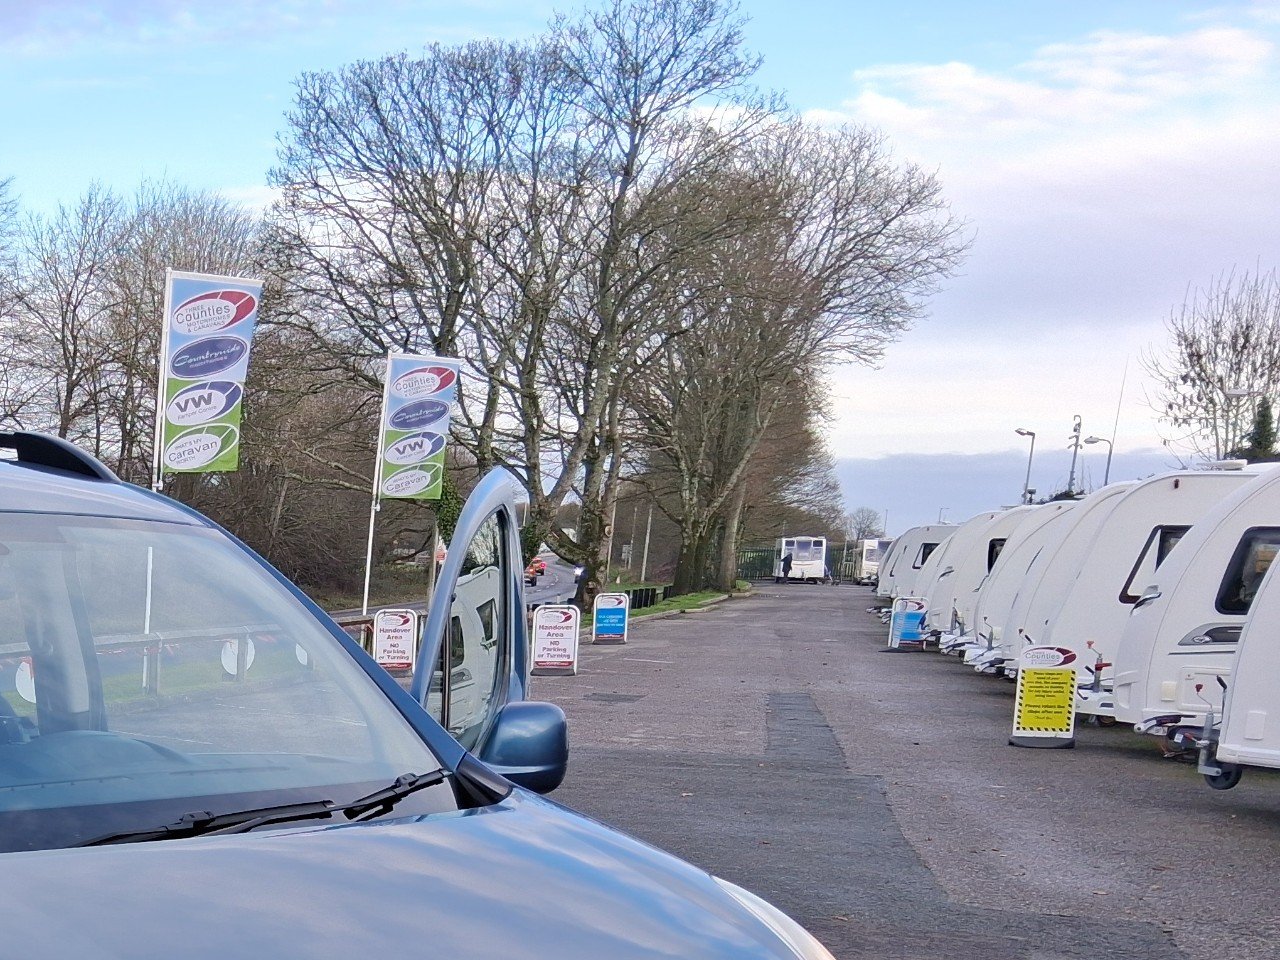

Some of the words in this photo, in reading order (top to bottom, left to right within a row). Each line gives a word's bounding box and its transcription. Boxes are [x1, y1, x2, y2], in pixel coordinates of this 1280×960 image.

[176, 305, 230, 324] Counties
[395, 376, 436, 391] Counties
[175, 392, 213, 413] VW
[168, 441, 218, 462] Caravan
[394, 439, 424, 456] VW
[387, 475, 427, 491] Caravan
[1025, 652, 1061, 660] Counties
